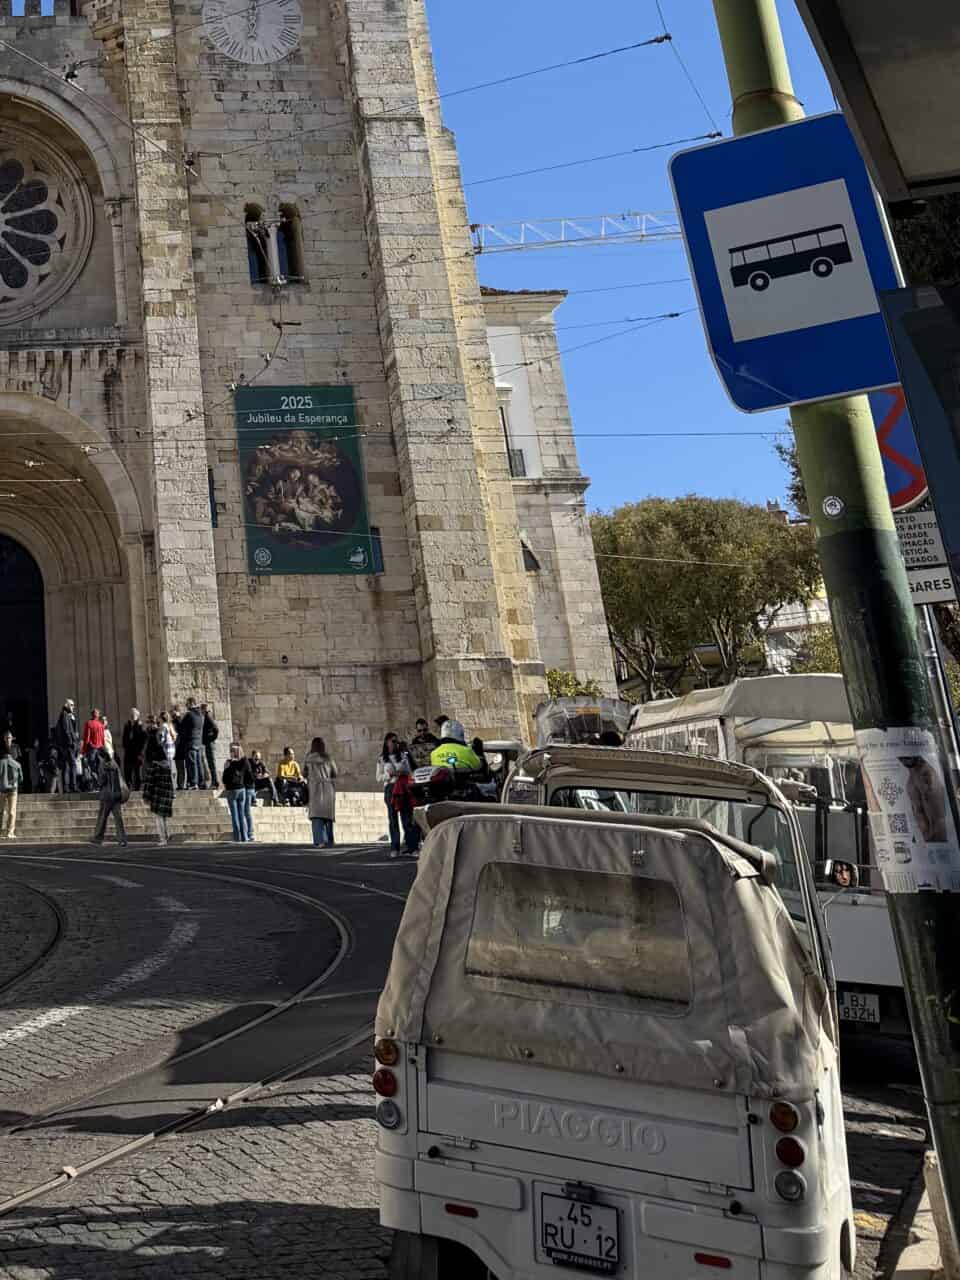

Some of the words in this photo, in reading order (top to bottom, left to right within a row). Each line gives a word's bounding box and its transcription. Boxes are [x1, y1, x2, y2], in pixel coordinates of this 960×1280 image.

[280, 396, 313, 409] 2025
[247, 413, 282, 423] Jubileu
[284, 413, 296, 423] da
[298, 413, 348, 425] Esperança
[493, 1103, 667, 1155] PIAGGIO
[567, 1202, 592, 1227] 45
